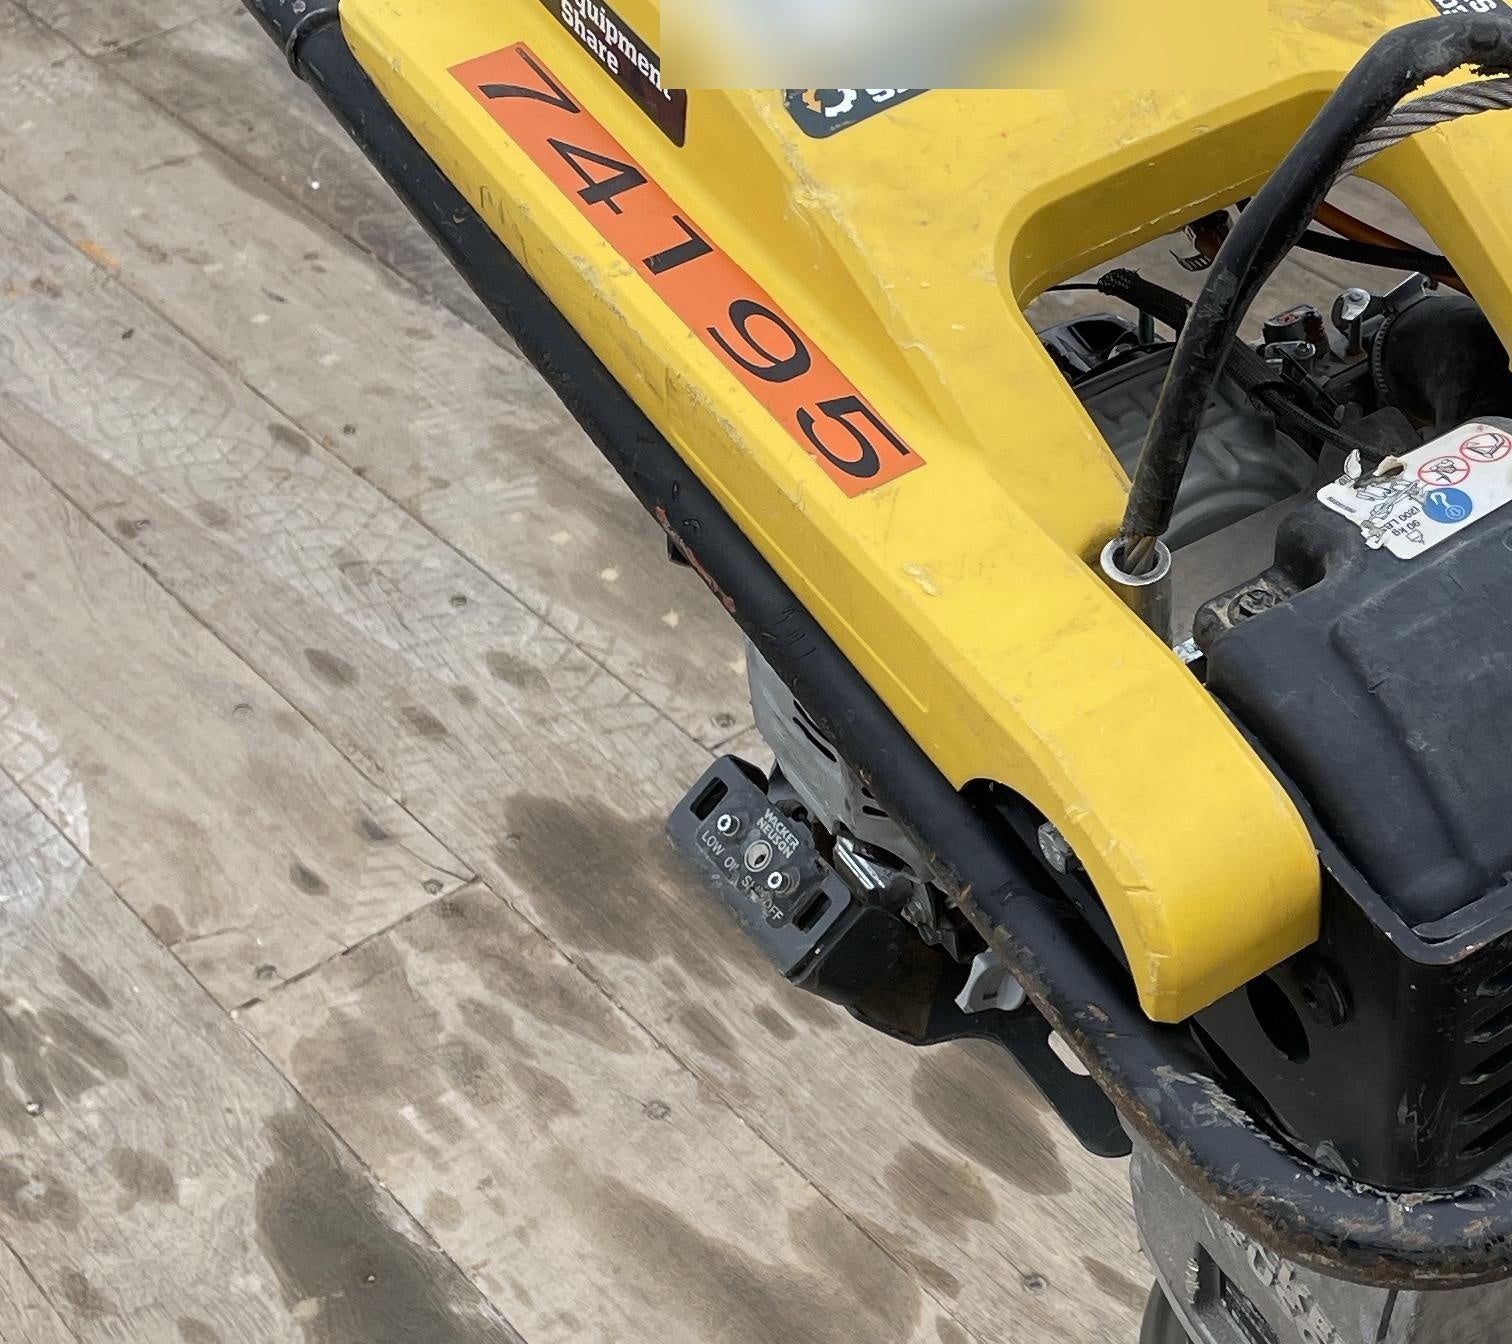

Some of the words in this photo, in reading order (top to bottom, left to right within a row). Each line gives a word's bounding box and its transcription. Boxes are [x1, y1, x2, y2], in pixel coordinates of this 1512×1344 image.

[477, 45, 912, 479] 74195
[701, 829, 726, 856] LOW
[756, 816, 794, 859] NEUSON
[763, 807, 800, 851] WACKER
